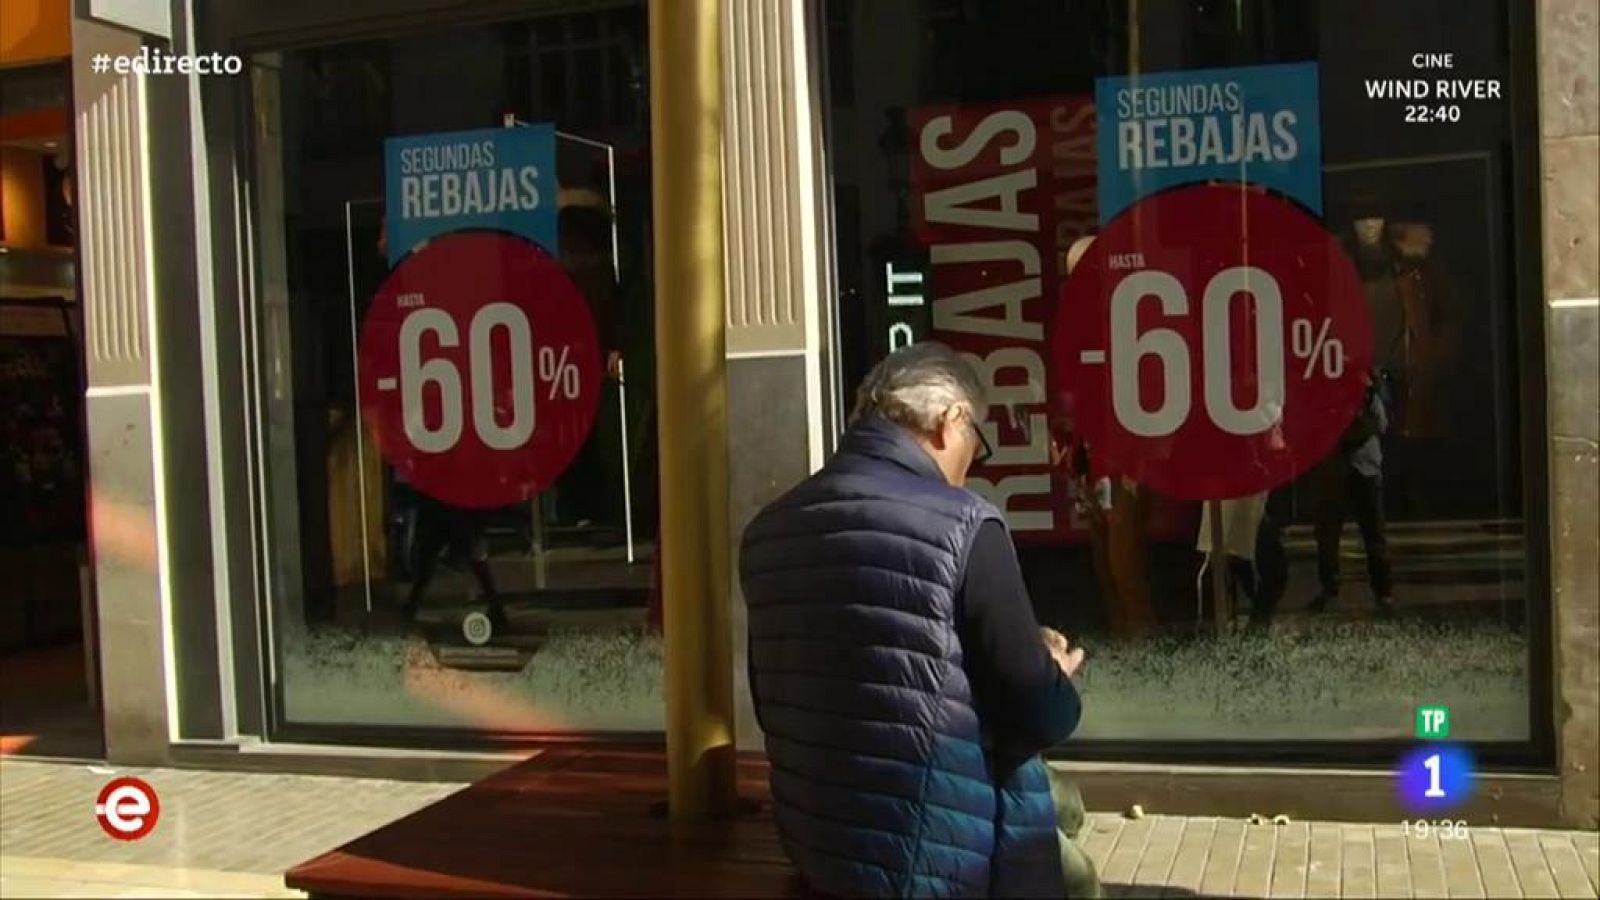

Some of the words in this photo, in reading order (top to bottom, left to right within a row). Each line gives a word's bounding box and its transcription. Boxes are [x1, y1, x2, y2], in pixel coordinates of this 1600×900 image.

[1116, 81, 1239, 118] SEGUNDAS
[400, 141, 495, 175] SEGUNDAS
[1118, 110, 1298, 170] REBAJAS
[402, 166, 539, 219] REBAJAS
[886, 262, 924, 306] IT
[1109, 253, 1145, 269] HASTA
[1080, 266, 1344, 437] -60%
[377, 302, 580, 453] -60%
